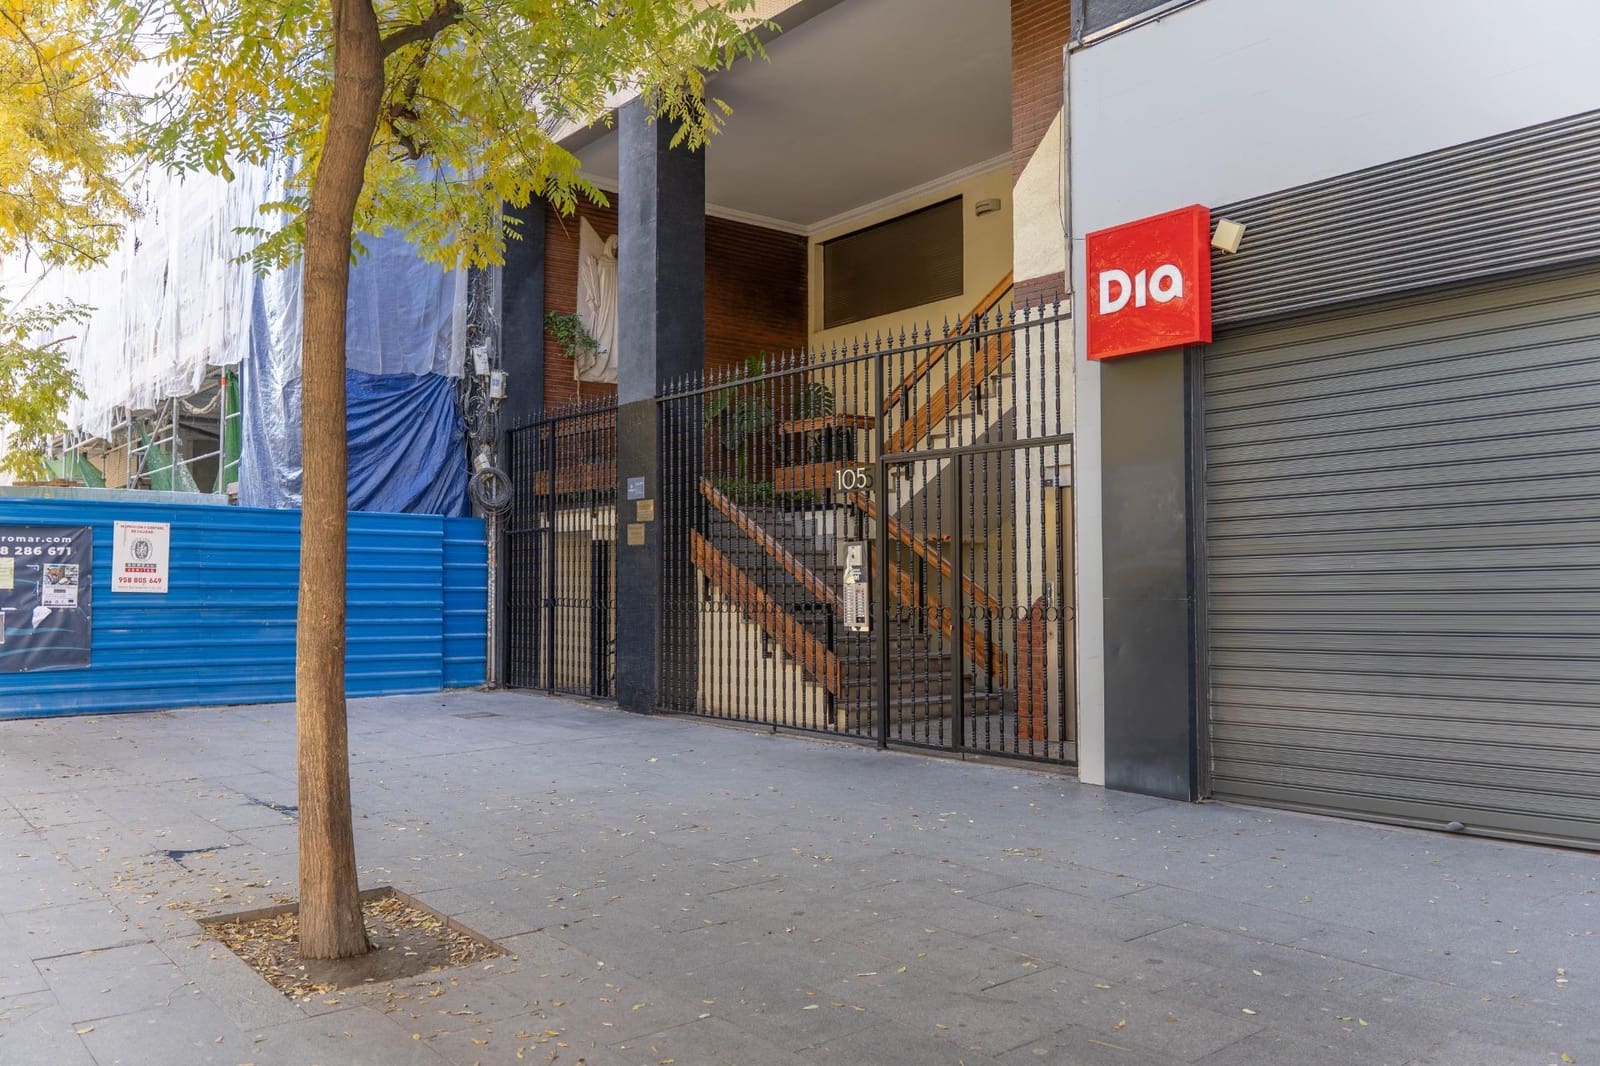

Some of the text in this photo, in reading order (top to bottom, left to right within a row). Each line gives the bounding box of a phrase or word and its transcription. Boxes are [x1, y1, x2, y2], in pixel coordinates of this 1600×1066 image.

[836, 468, 867, 490] 105
[14, 546, 42, 555] 286
[47, 546, 71, 556] 671
